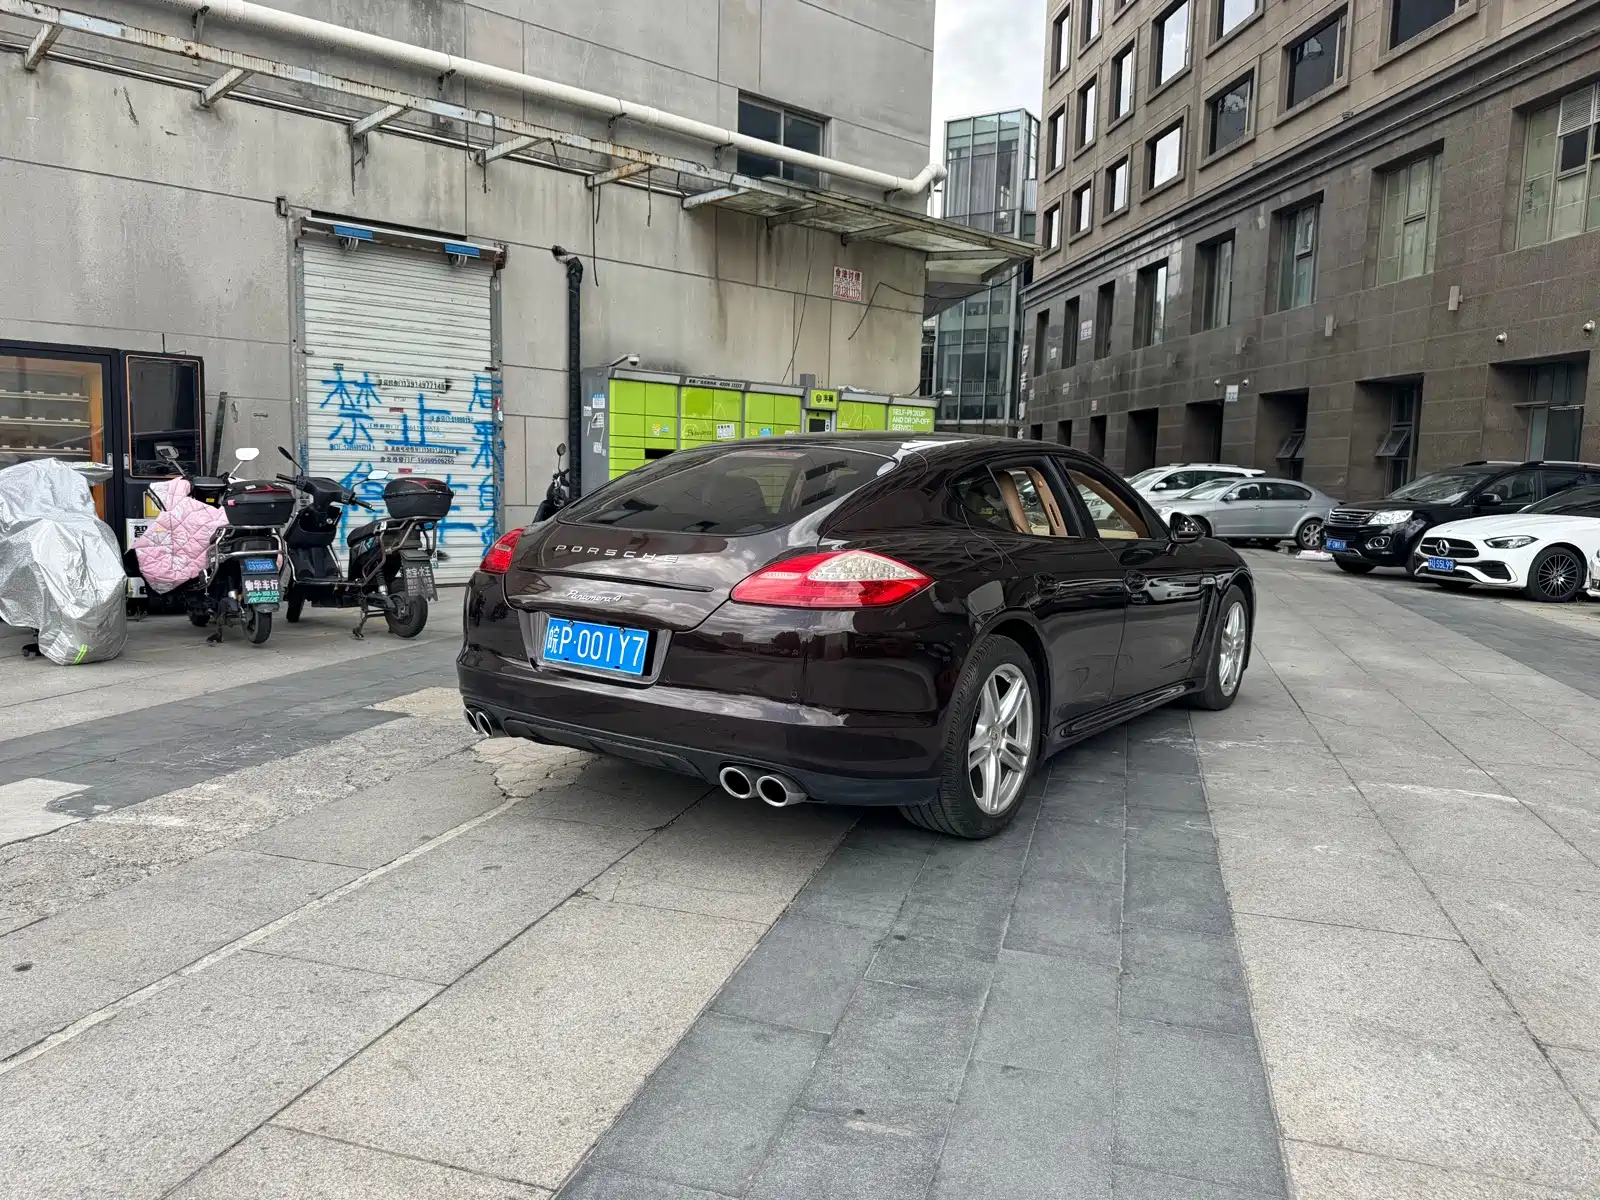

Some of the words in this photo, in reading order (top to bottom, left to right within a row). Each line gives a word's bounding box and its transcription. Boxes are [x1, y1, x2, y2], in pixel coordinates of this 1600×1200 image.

[320, 366, 468, 451] 禁止
[555, 544, 679, 563] PORSCHE
[566, 590, 611, 602] Panamera
